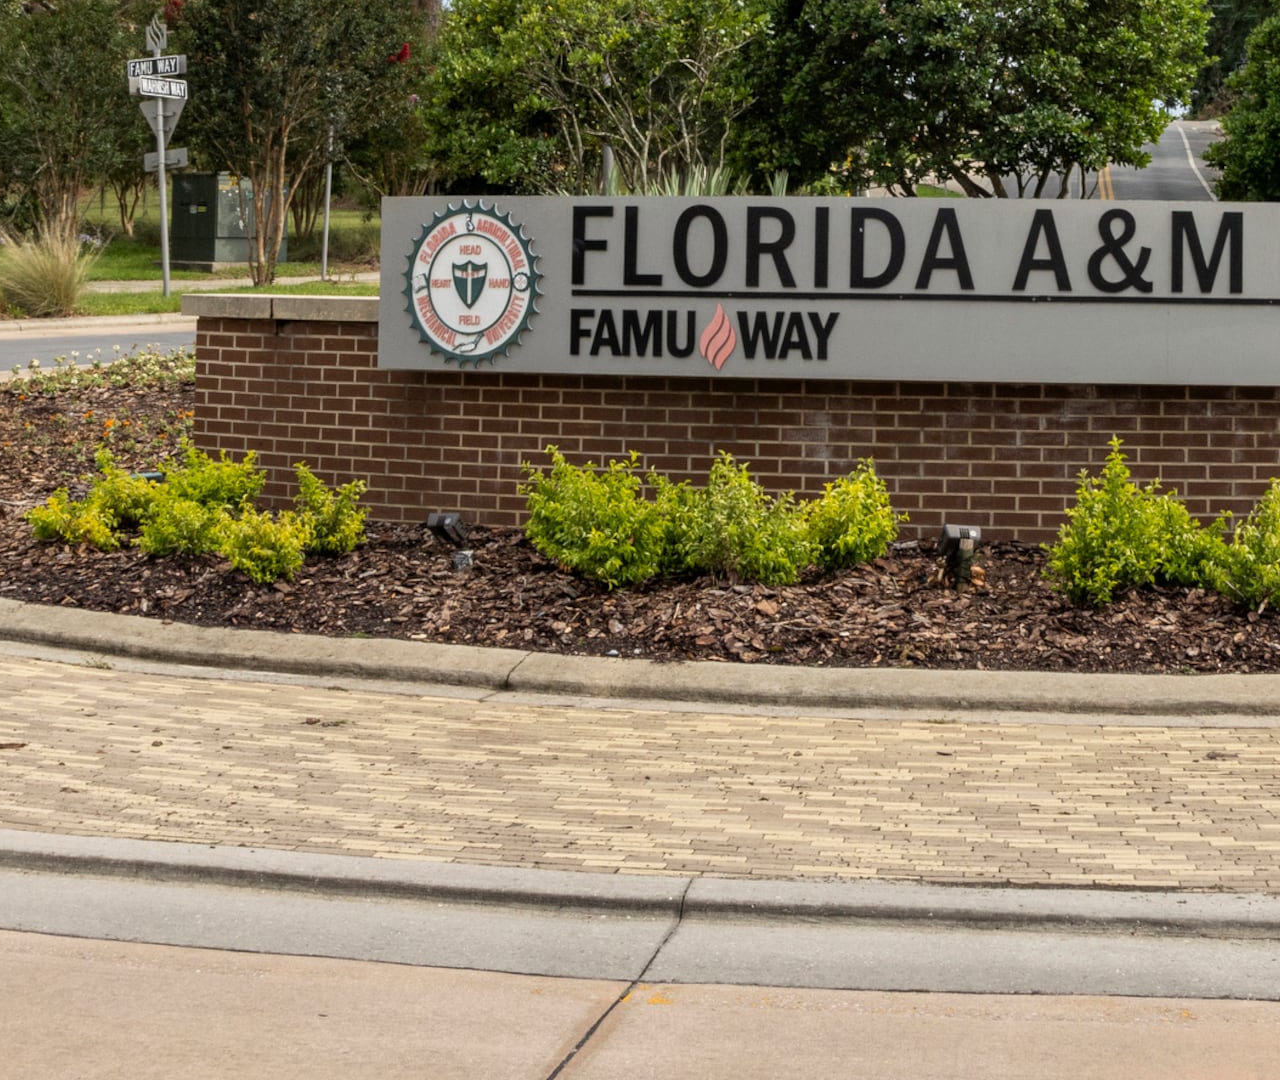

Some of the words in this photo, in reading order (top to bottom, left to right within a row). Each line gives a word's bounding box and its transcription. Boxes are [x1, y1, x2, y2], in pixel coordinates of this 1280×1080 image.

[130, 62, 152, 76] FAMU
[157, 59, 176, 73] WAY
[171, 83, 185, 96] WAY
[419, 221, 457, 265] FLORIDA
[459, 245, 482, 255] HEAD
[476, 218, 526, 271] AGRICULTURAL
[570, 205, 976, 291] FLORIDA
[1012, 208, 1244, 295] A&M
[431, 279, 452, 289] HEART
[488, 278, 510, 289] HAND
[416, 295, 458, 347] MECHANICAL
[458, 315, 481, 326] FIELD
[485, 294, 525, 346] UNIVERSITY
[569, 308, 697, 360] FAMU
[736, 310, 841, 362] WAY
